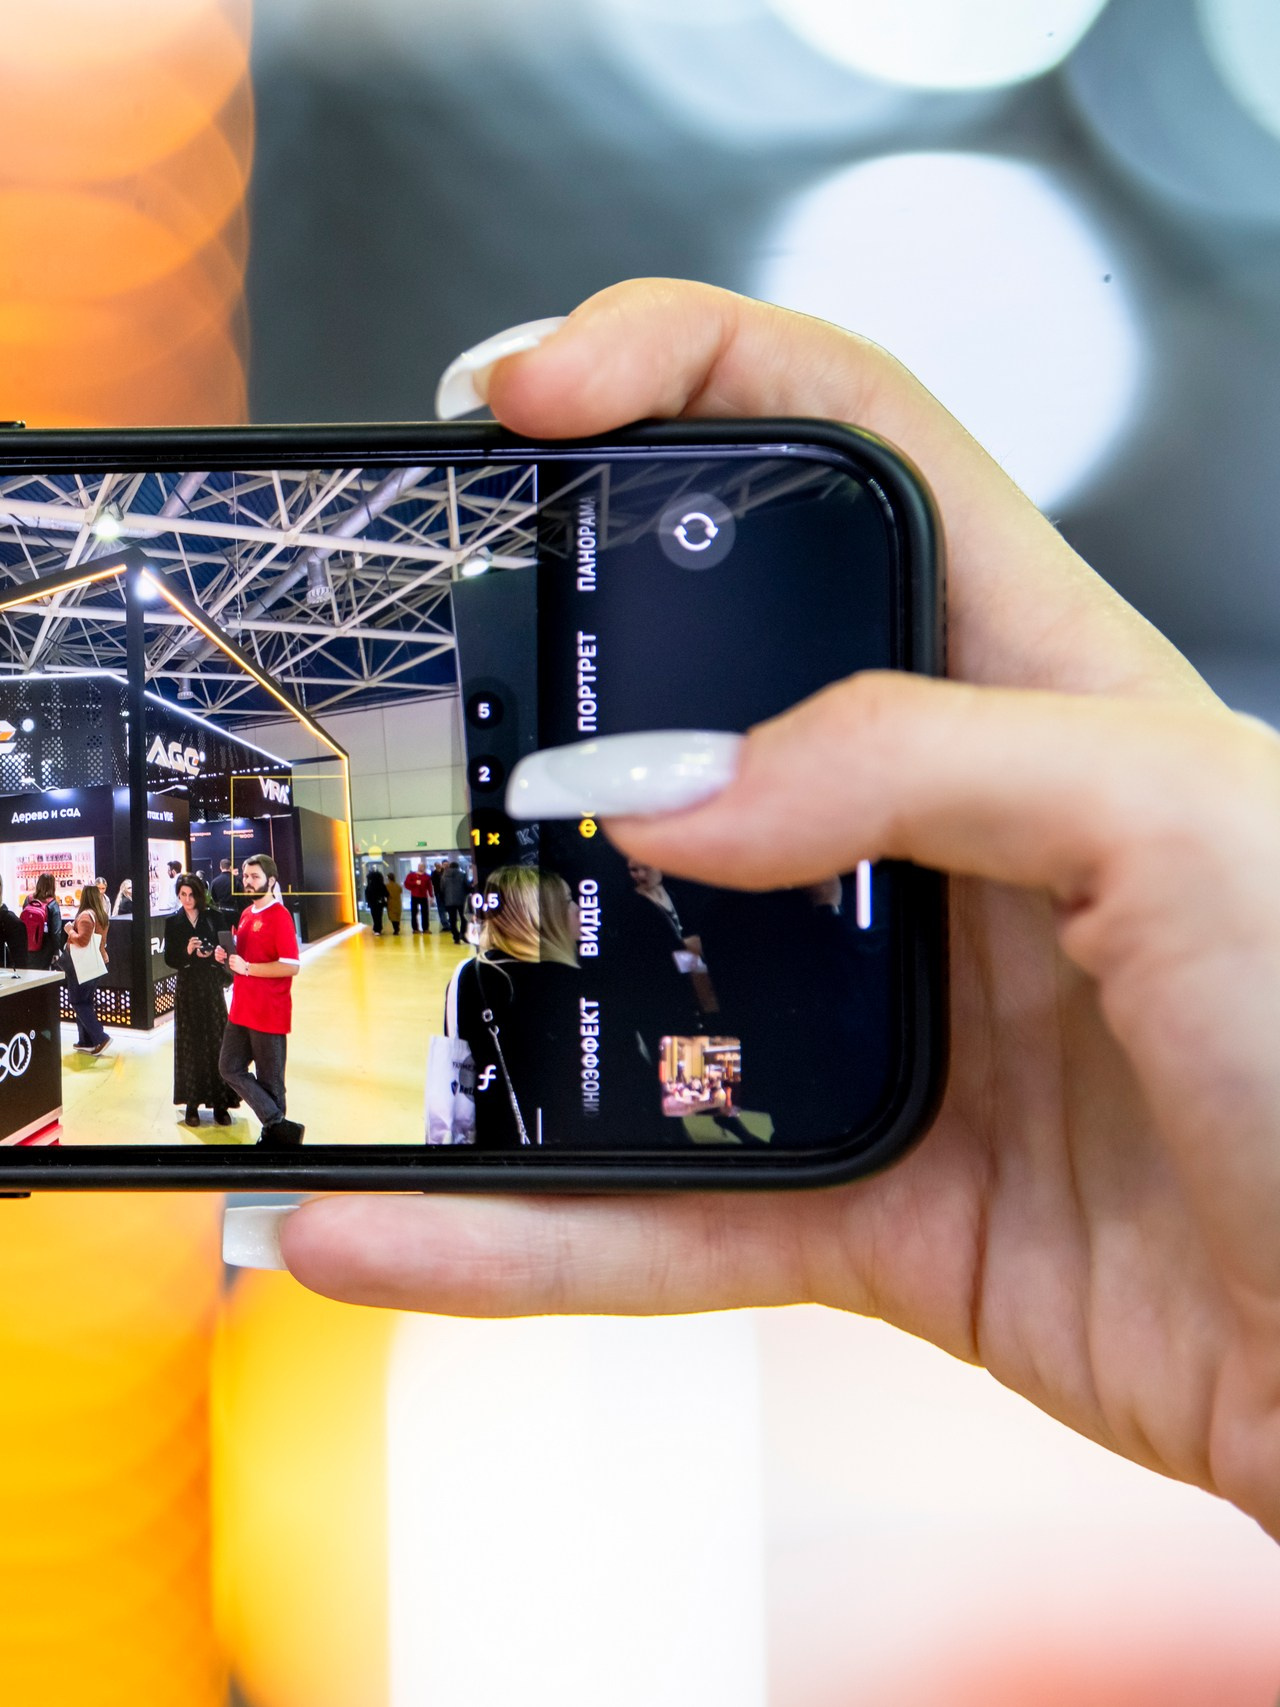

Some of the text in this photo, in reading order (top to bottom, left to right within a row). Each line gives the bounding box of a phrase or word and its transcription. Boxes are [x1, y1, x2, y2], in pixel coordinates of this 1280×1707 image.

[577, 497, 596, 592] ПАНОРАМА
[577, 630, 597, 732] ПОРТРЕТ
[477, 703, 491, 718] 5
[146, 735, 201, 776] AGE
[478, 766, 491, 782] 2
[11, 807, 81, 824] Дерево и сад
[471, 893, 499, 911] 0,5
[579, 879, 601, 957] ВИДЕО
[580, 997, 600, 1117] ИНОЭФФЕКТ
